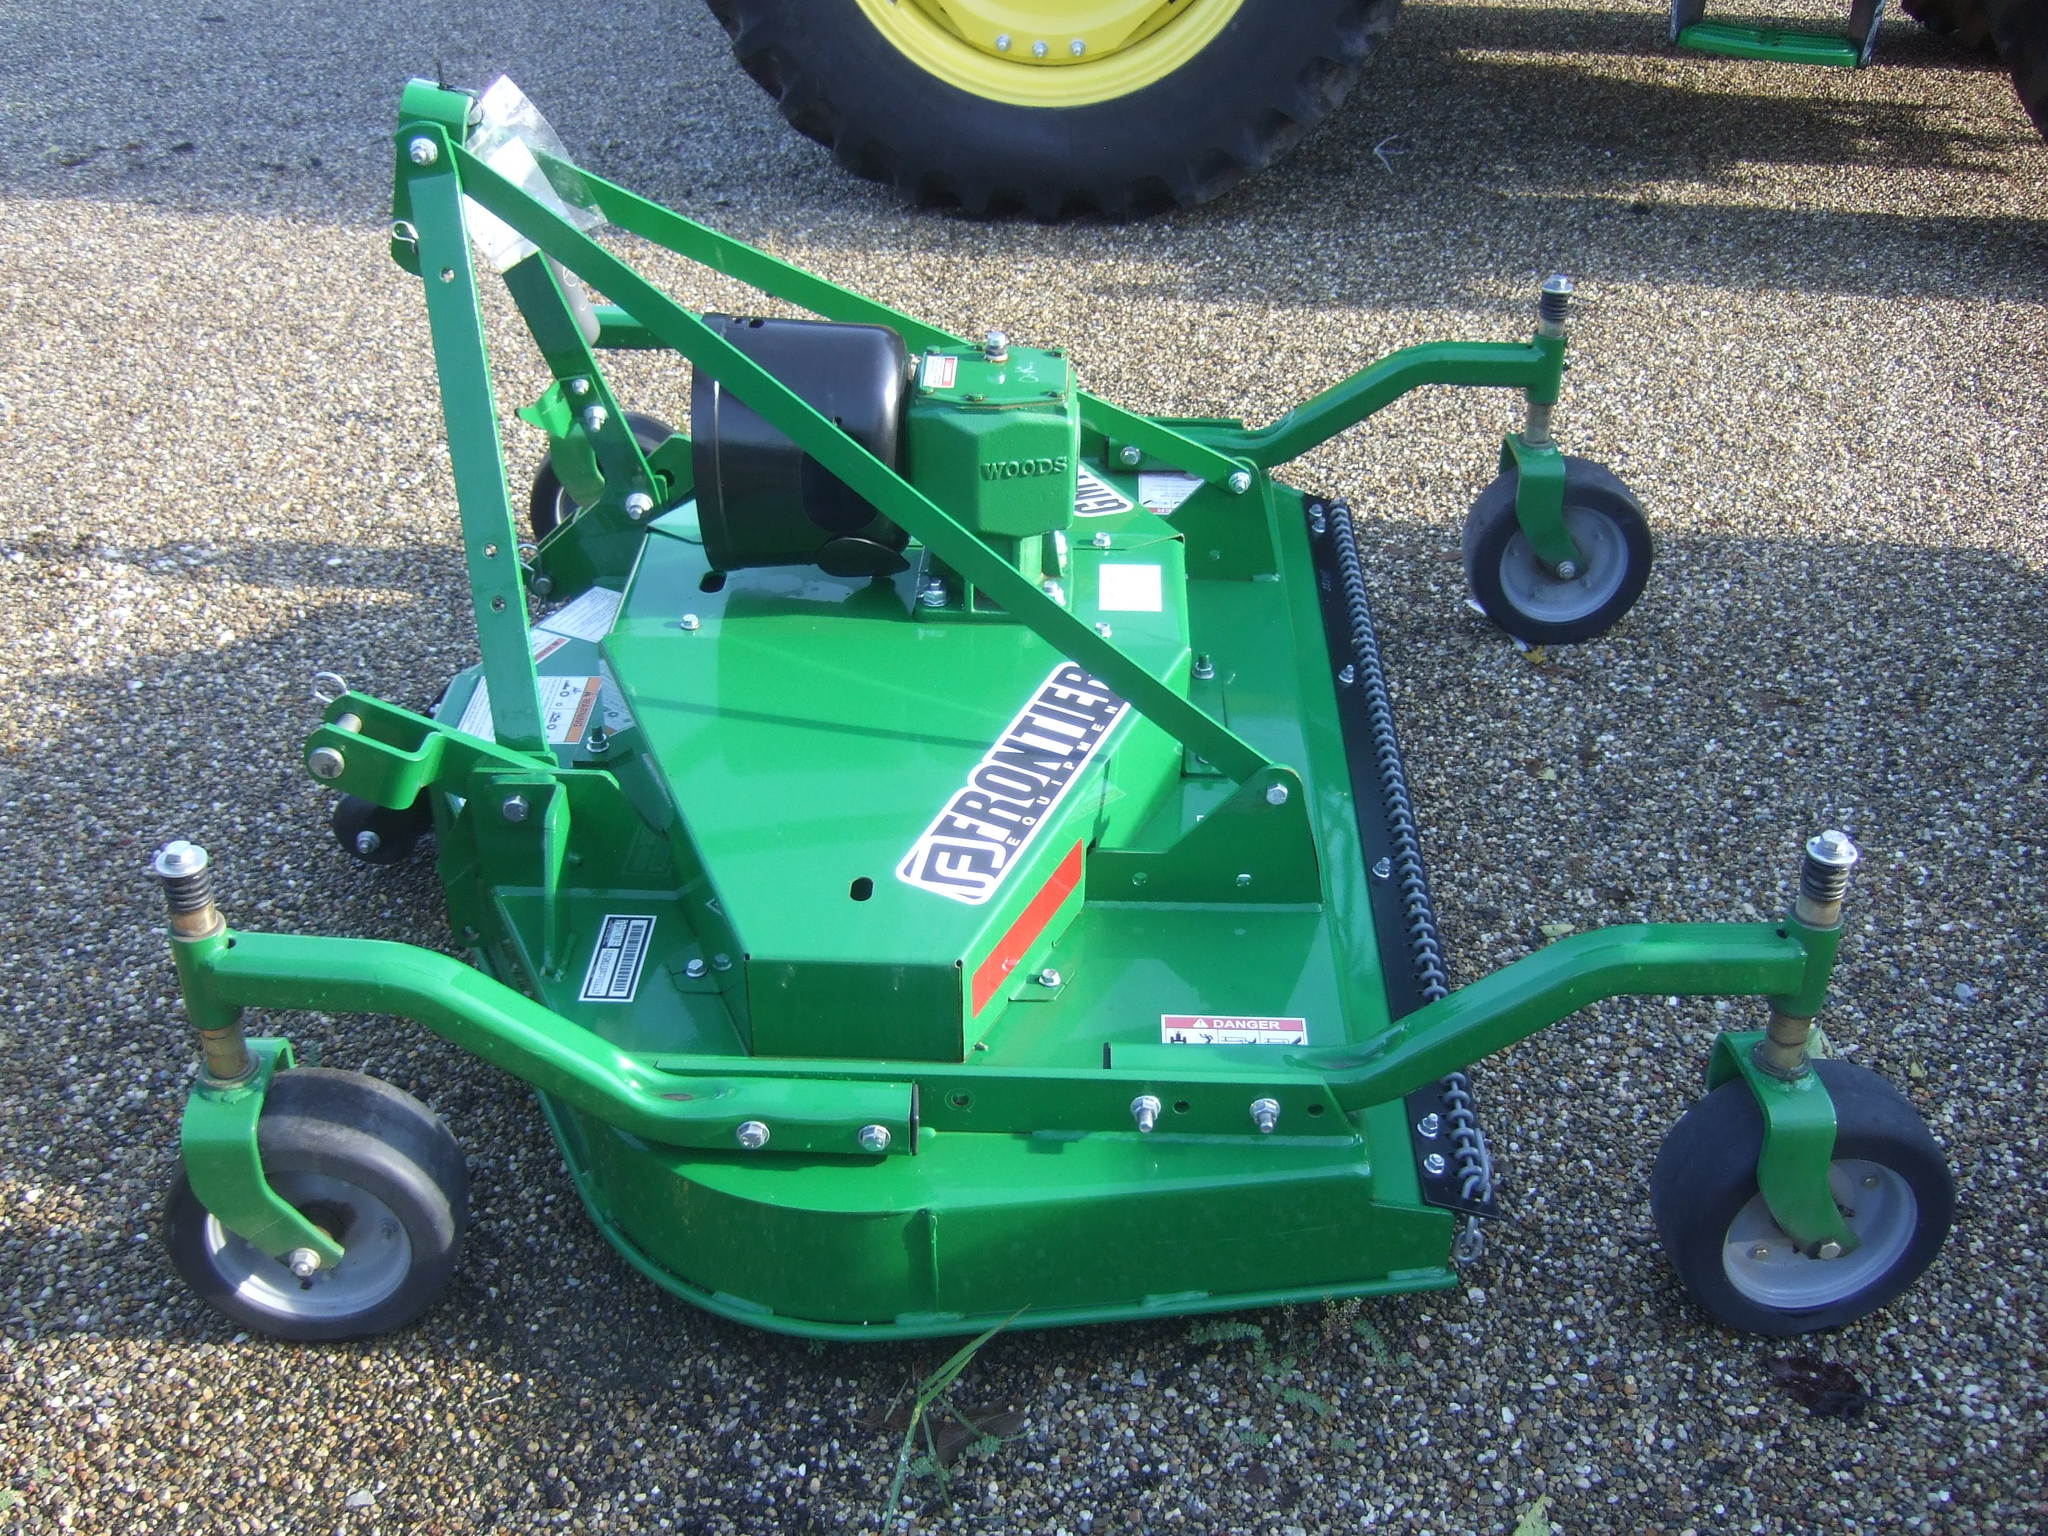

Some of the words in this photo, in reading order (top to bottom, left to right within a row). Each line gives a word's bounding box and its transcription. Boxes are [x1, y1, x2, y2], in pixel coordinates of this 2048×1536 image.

[981, 456, 1068, 480] WOODS
[930, 665, 1111, 842] FRONTIER
[1007, 705, 1119, 847] EQUIPMEN
[1212, 1019, 1281, 1030] DANGER
